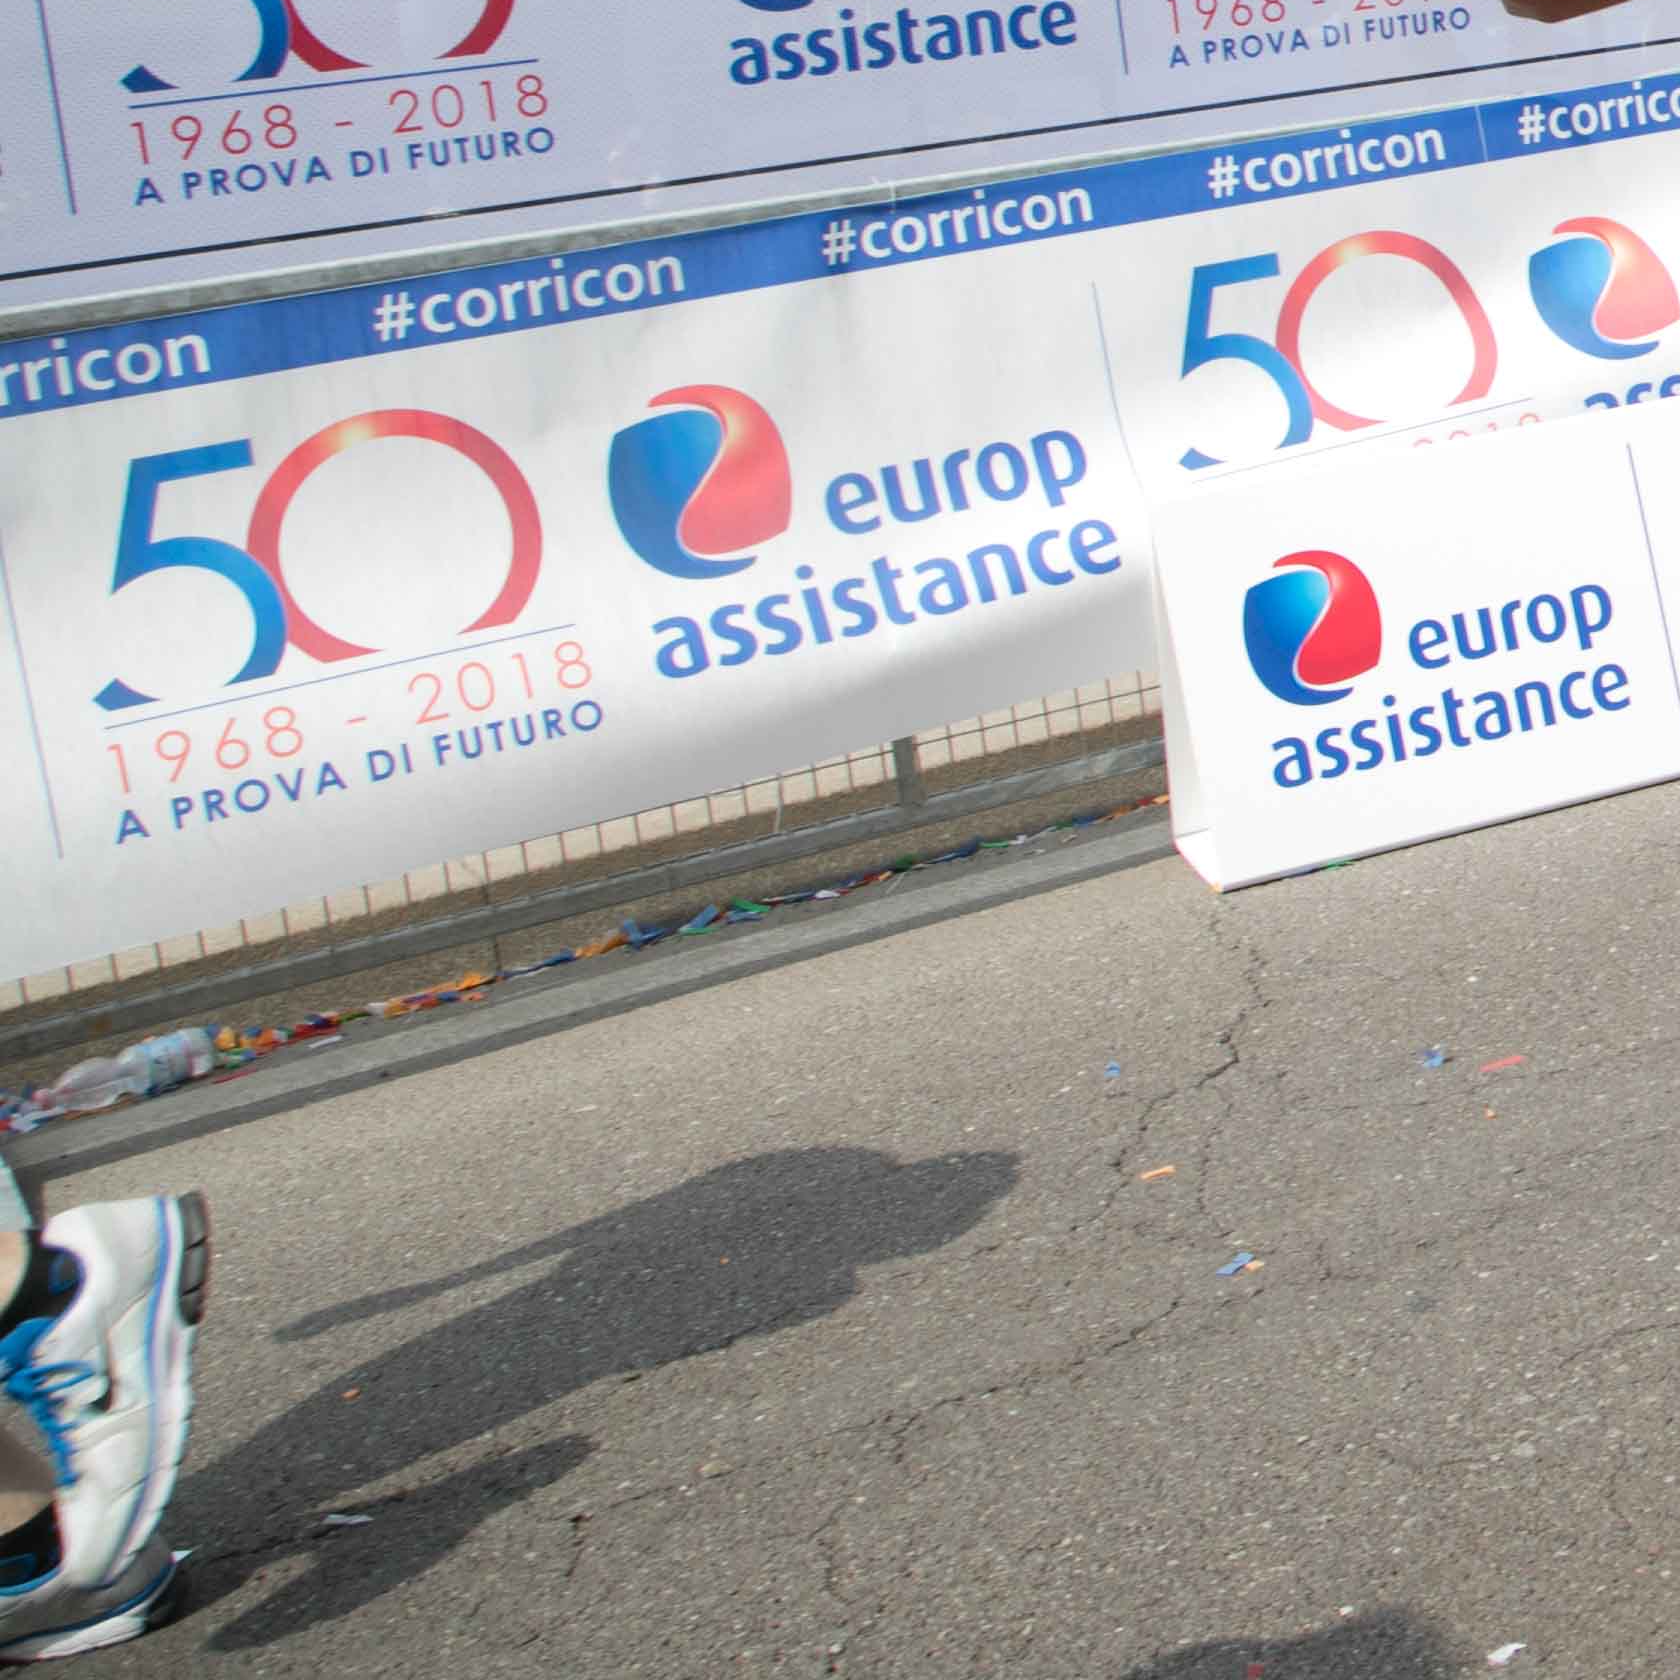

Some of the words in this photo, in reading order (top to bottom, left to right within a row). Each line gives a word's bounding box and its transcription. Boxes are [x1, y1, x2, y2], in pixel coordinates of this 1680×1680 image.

[1168, 45, 1190, 69] A
[1203, 28, 1309, 64] PROVA
[1323, 19, 1352, 48] DI
[1364, 7, 1472, 42] FUTURO
[132, 103, 299, 166] 1968
[390, 74, 550, 137] 2018
[133, 178, 165, 206] A
[183, 157, 329, 201] PROVA
[349, 146, 390, 179] DI
[408, 127, 557, 170] FUTURO
[1207, 126, 1447, 201] #corricon
[820, 183, 1095, 267] #corricon
[373, 254, 686, 342] #corricon
[1178, 231, 1499, 472] 50
[823, 428, 1089, 536] europ
[93, 409, 544, 711] 50
[651, 518, 1122, 680] assistance
[1409, 582, 1614, 670] europ
[107, 707, 305, 796] 1968
[407, 641, 593, 726] 2018
[1272, 661, 1632, 789] assistance
[115, 810, 150, 845] A
[172, 762, 347, 831] PROVA
[368, 744, 412, 782] DI
[433, 700, 605, 767] FUTURO
